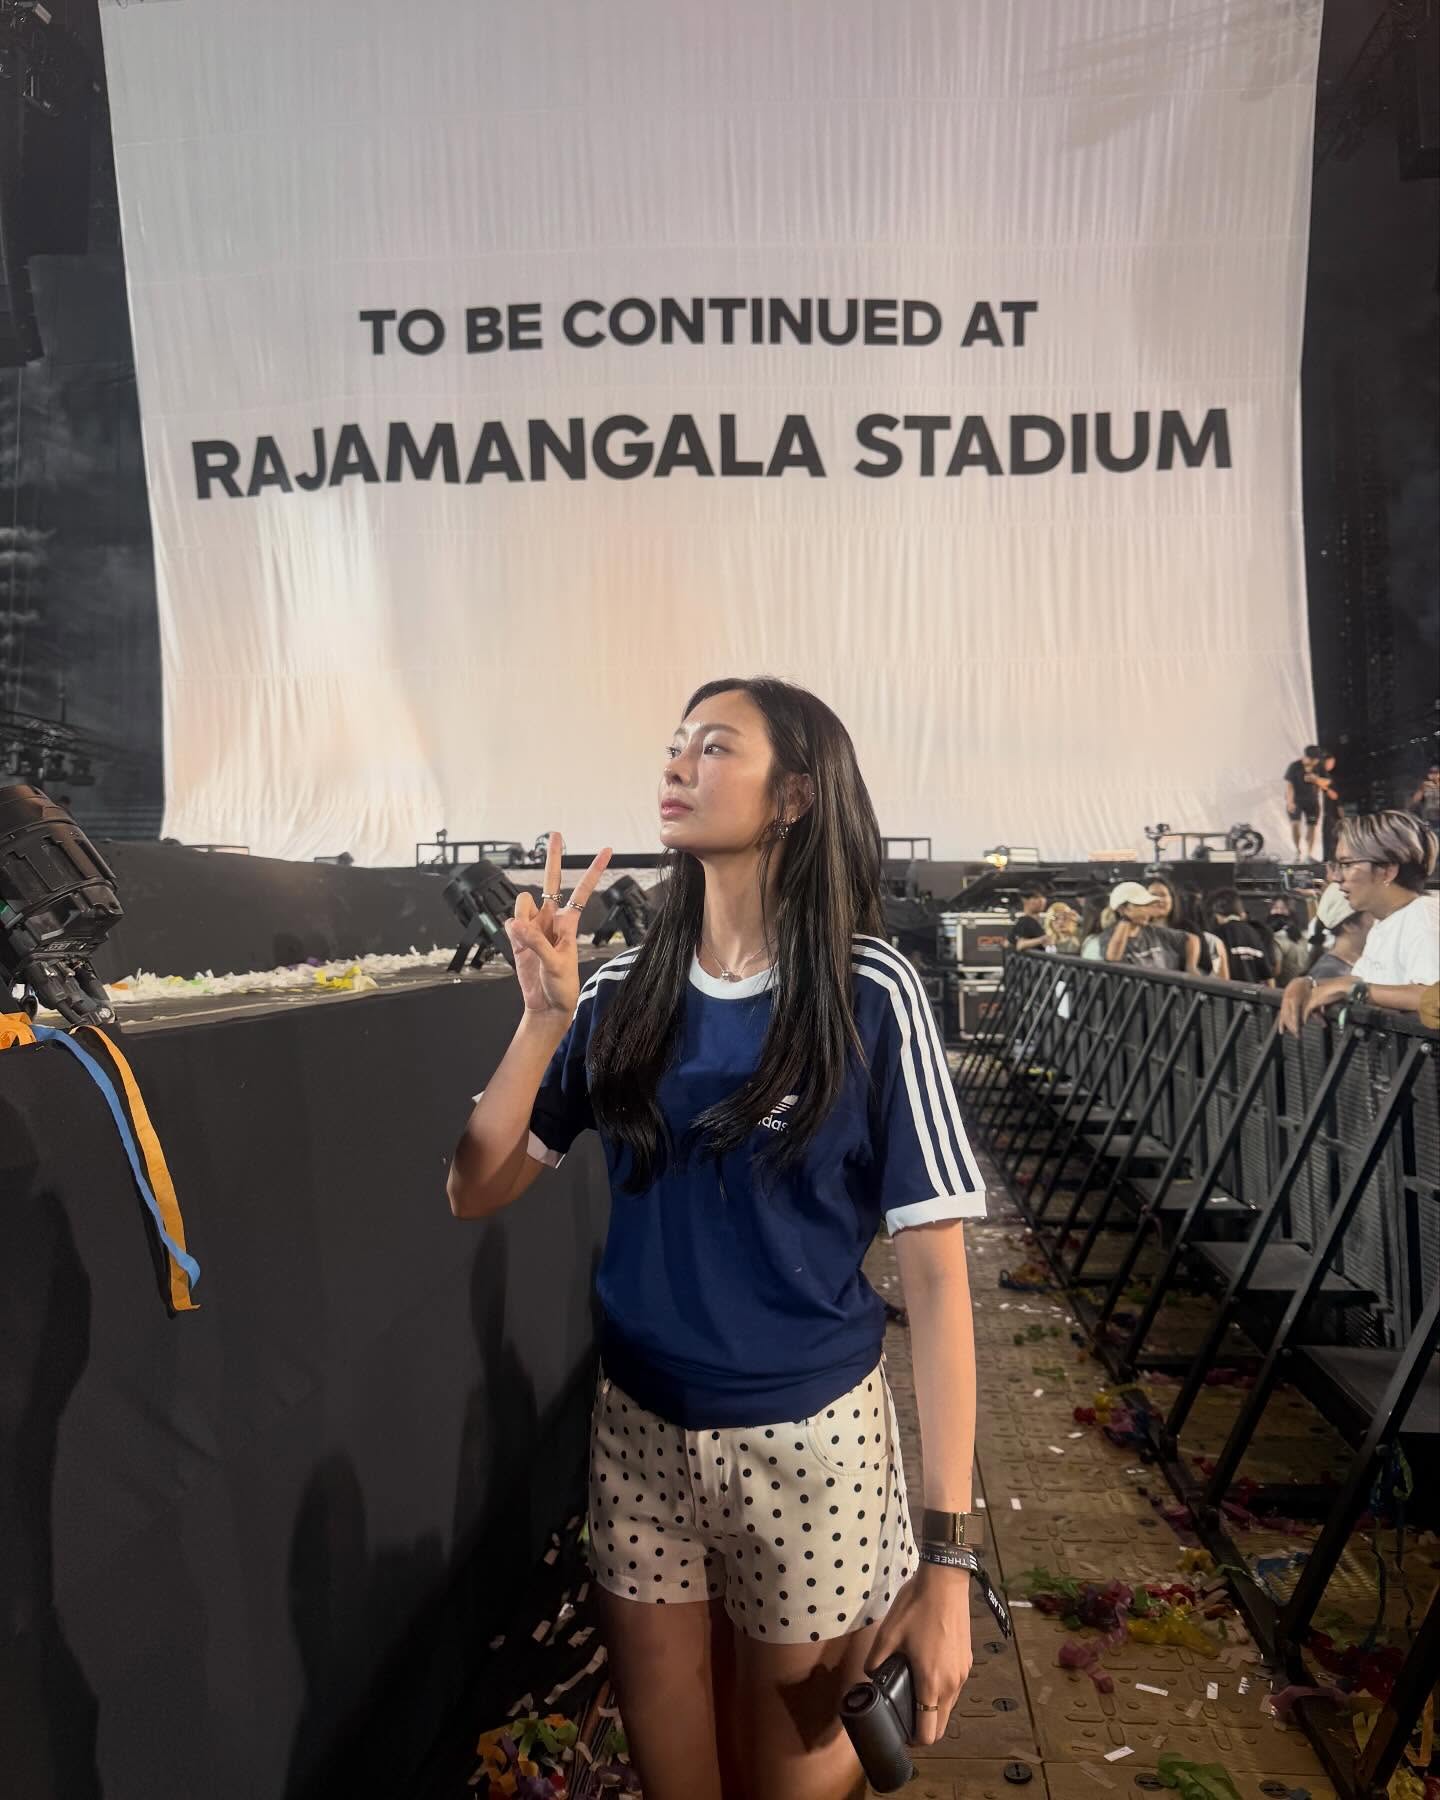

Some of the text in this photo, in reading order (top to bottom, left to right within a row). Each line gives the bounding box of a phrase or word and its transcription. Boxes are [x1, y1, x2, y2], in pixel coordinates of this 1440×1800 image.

[359, 297, 1039, 356] TO BE CONTINUED AT
[192, 408, 1232, 500] RAJAMANGALA STADIUM
[933, 1554, 968, 1567] THREE
